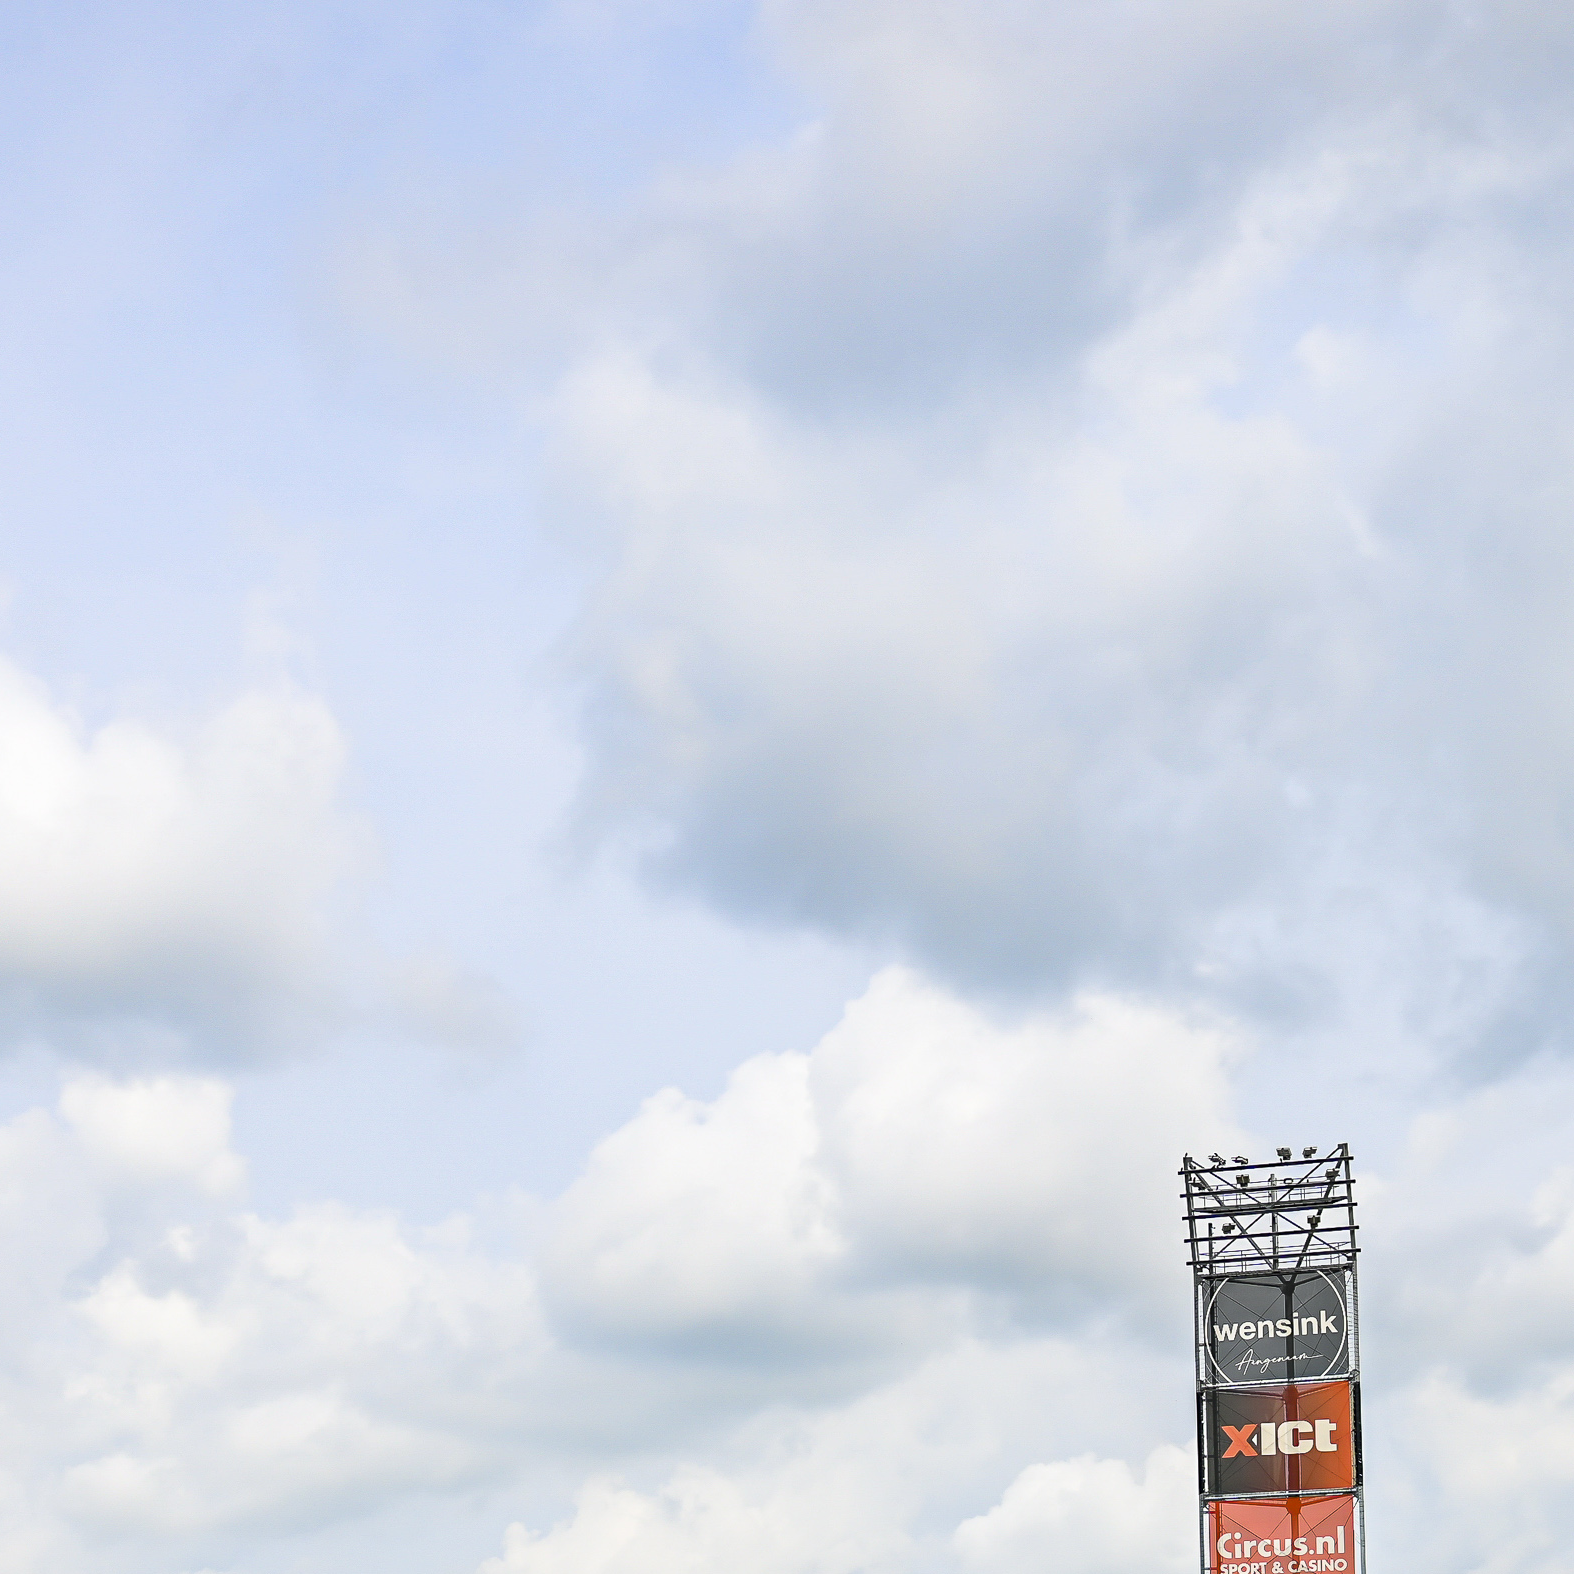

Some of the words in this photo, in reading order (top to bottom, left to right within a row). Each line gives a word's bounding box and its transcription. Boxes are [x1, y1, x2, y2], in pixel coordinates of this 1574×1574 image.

[1213, 1310, 1339, 1342] wensink
[1217, 1525, 1346, 1559] Circus.nl
[1272, 1561, 1285, 1574] &
[1288, 1558, 1348, 1574] CASINO
